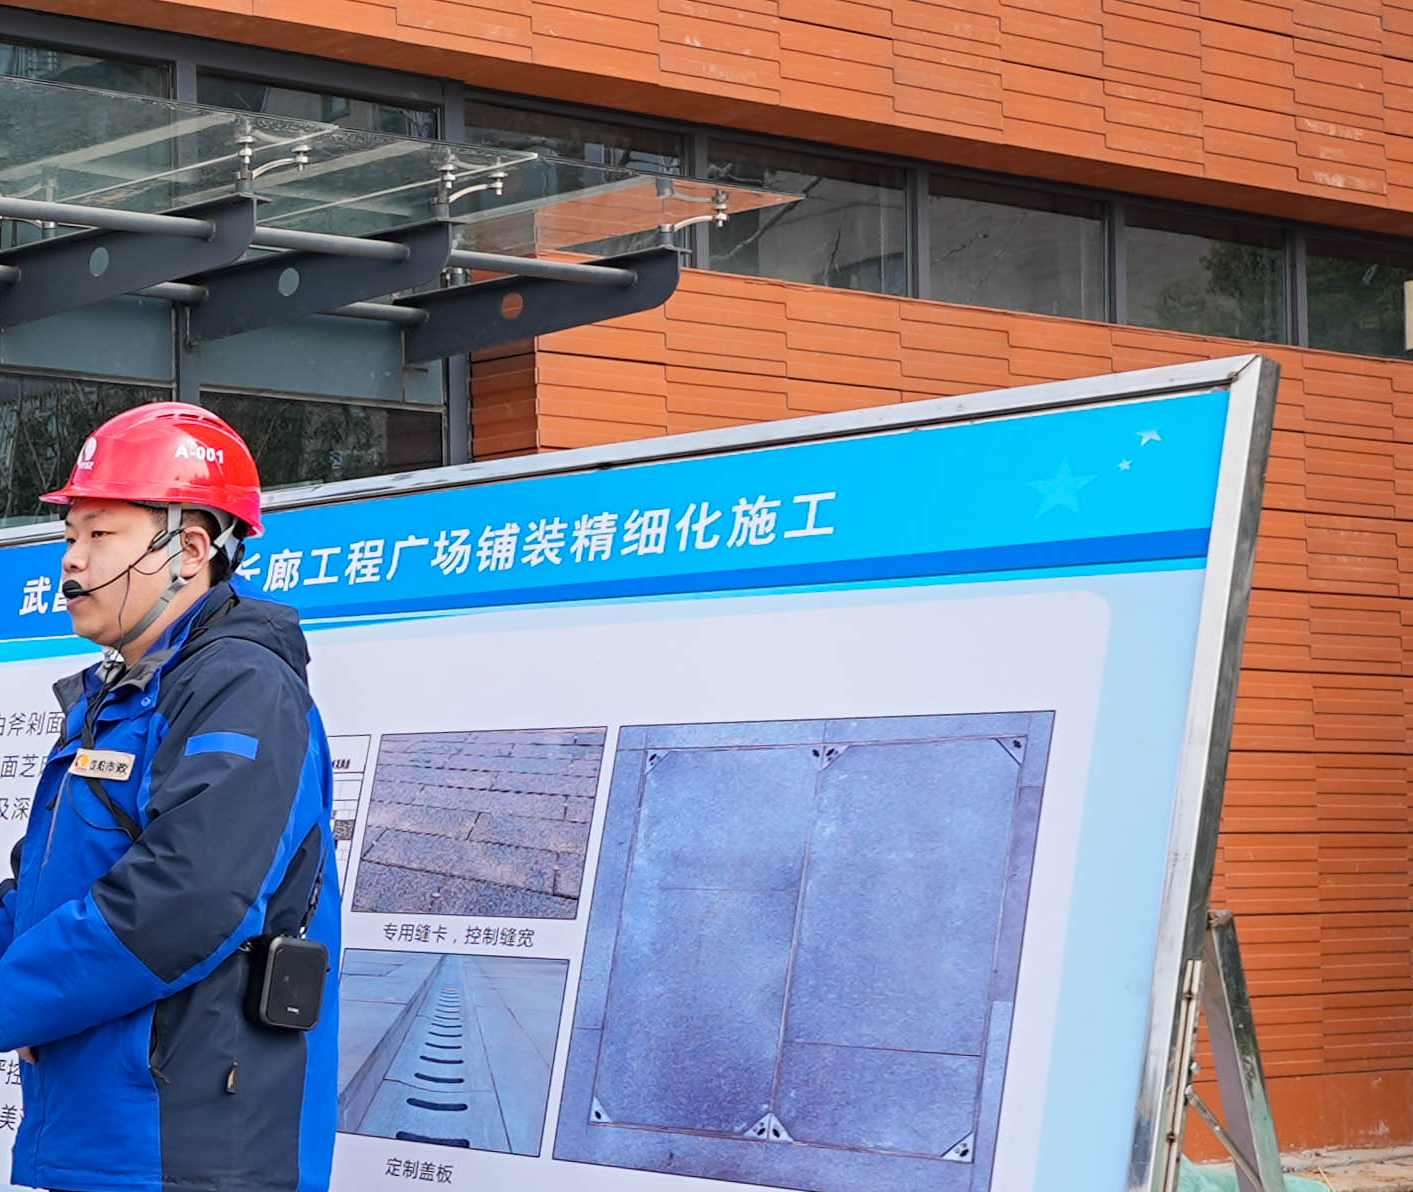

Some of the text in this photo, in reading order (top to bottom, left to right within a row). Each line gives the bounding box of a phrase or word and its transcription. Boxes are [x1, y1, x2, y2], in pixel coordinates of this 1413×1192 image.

[174, 444, 224, 464] A-001
[383, 922, 535, 948] 专用缝卡，控制缝宽
[384, 1156, 454, 1185] 定制盖板
